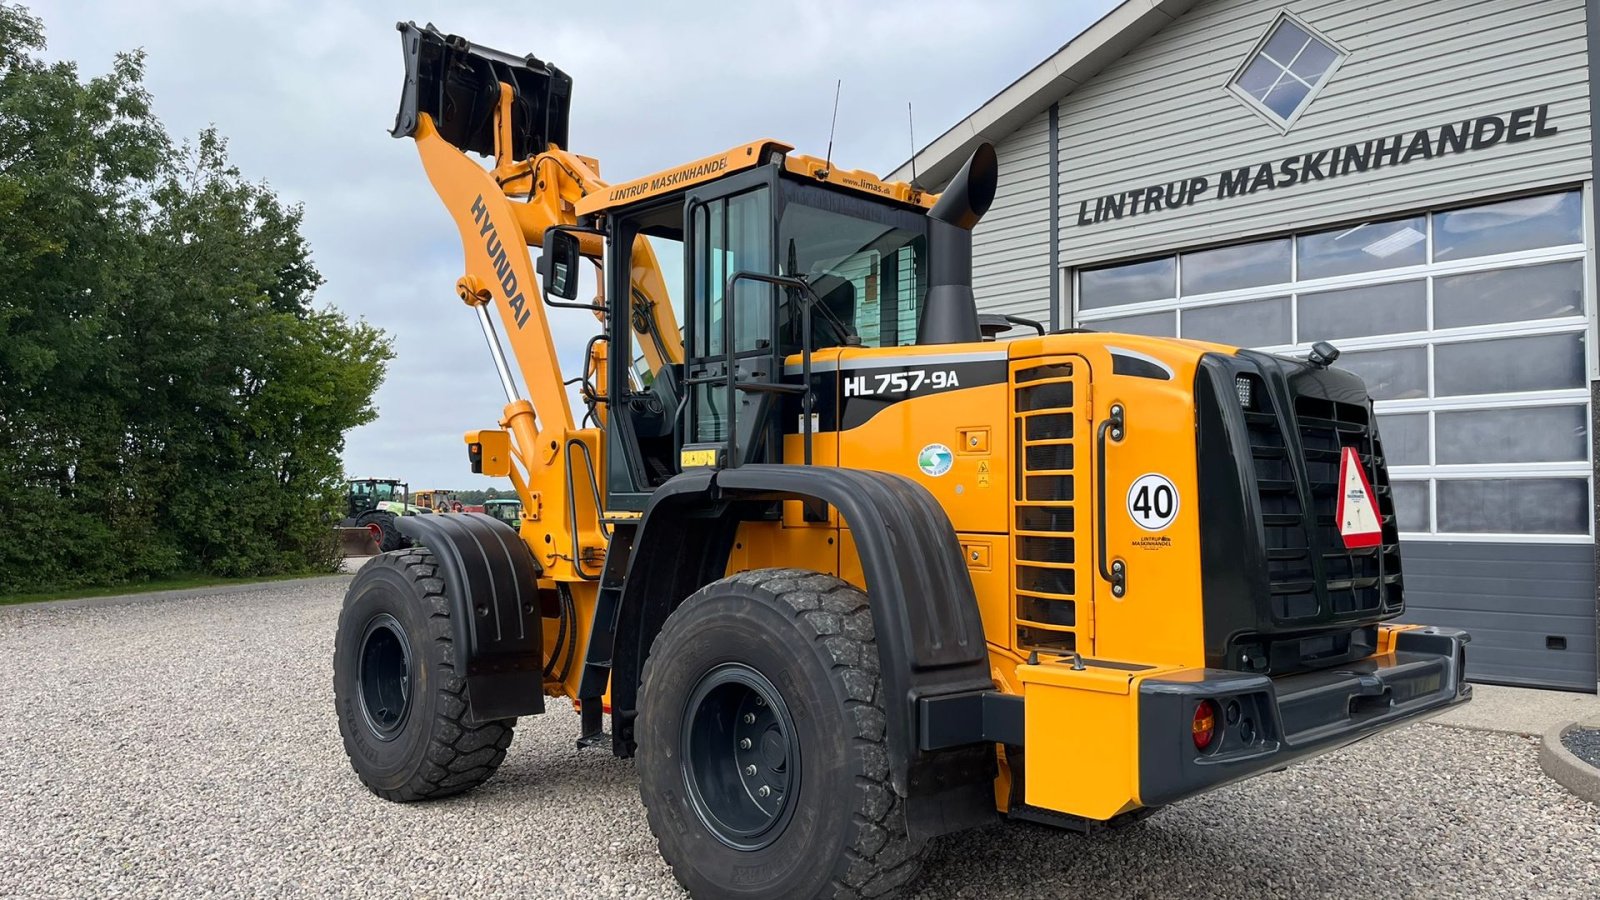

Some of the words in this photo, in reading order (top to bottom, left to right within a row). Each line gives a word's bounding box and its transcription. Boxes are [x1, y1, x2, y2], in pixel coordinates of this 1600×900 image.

[609, 182, 649, 202] LINTRUP
[650, 156, 728, 191] MASKINHANDEL
[1077, 177, 1208, 226] LINTRUP
[1217, 104, 1558, 200] MASKINHANDEL
[842, 177, 891, 195] www.limas.dk
[470, 193, 531, 330] HYUNDAI
[844, 370, 960, 397] HL757-9A
[1133, 484, 1173, 519] 40
